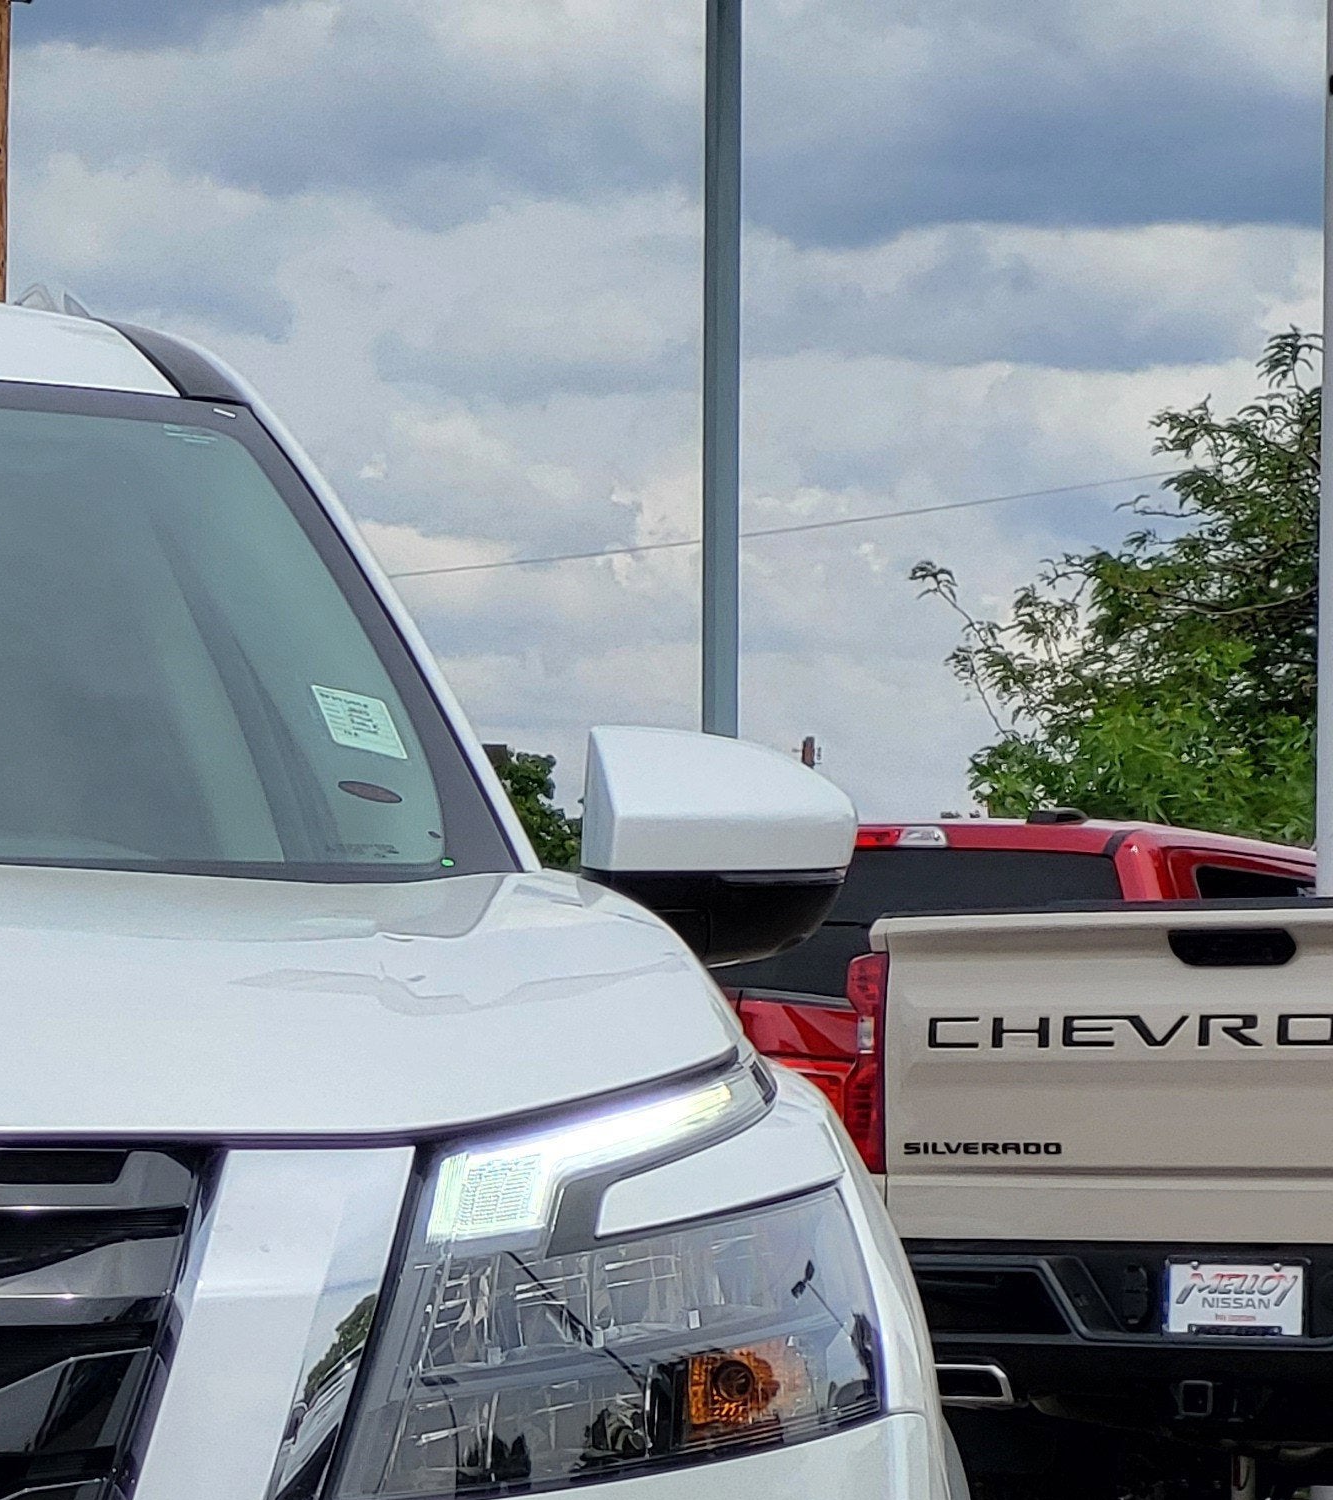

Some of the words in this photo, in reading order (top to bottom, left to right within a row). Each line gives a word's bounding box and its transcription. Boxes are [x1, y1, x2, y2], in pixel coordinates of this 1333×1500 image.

[927, 1014, 1333, 1049] CHEVRO
[903, 1142, 1063, 1156] SILVERADO
[1201, 1297, 1271, 1310] NISSAN
